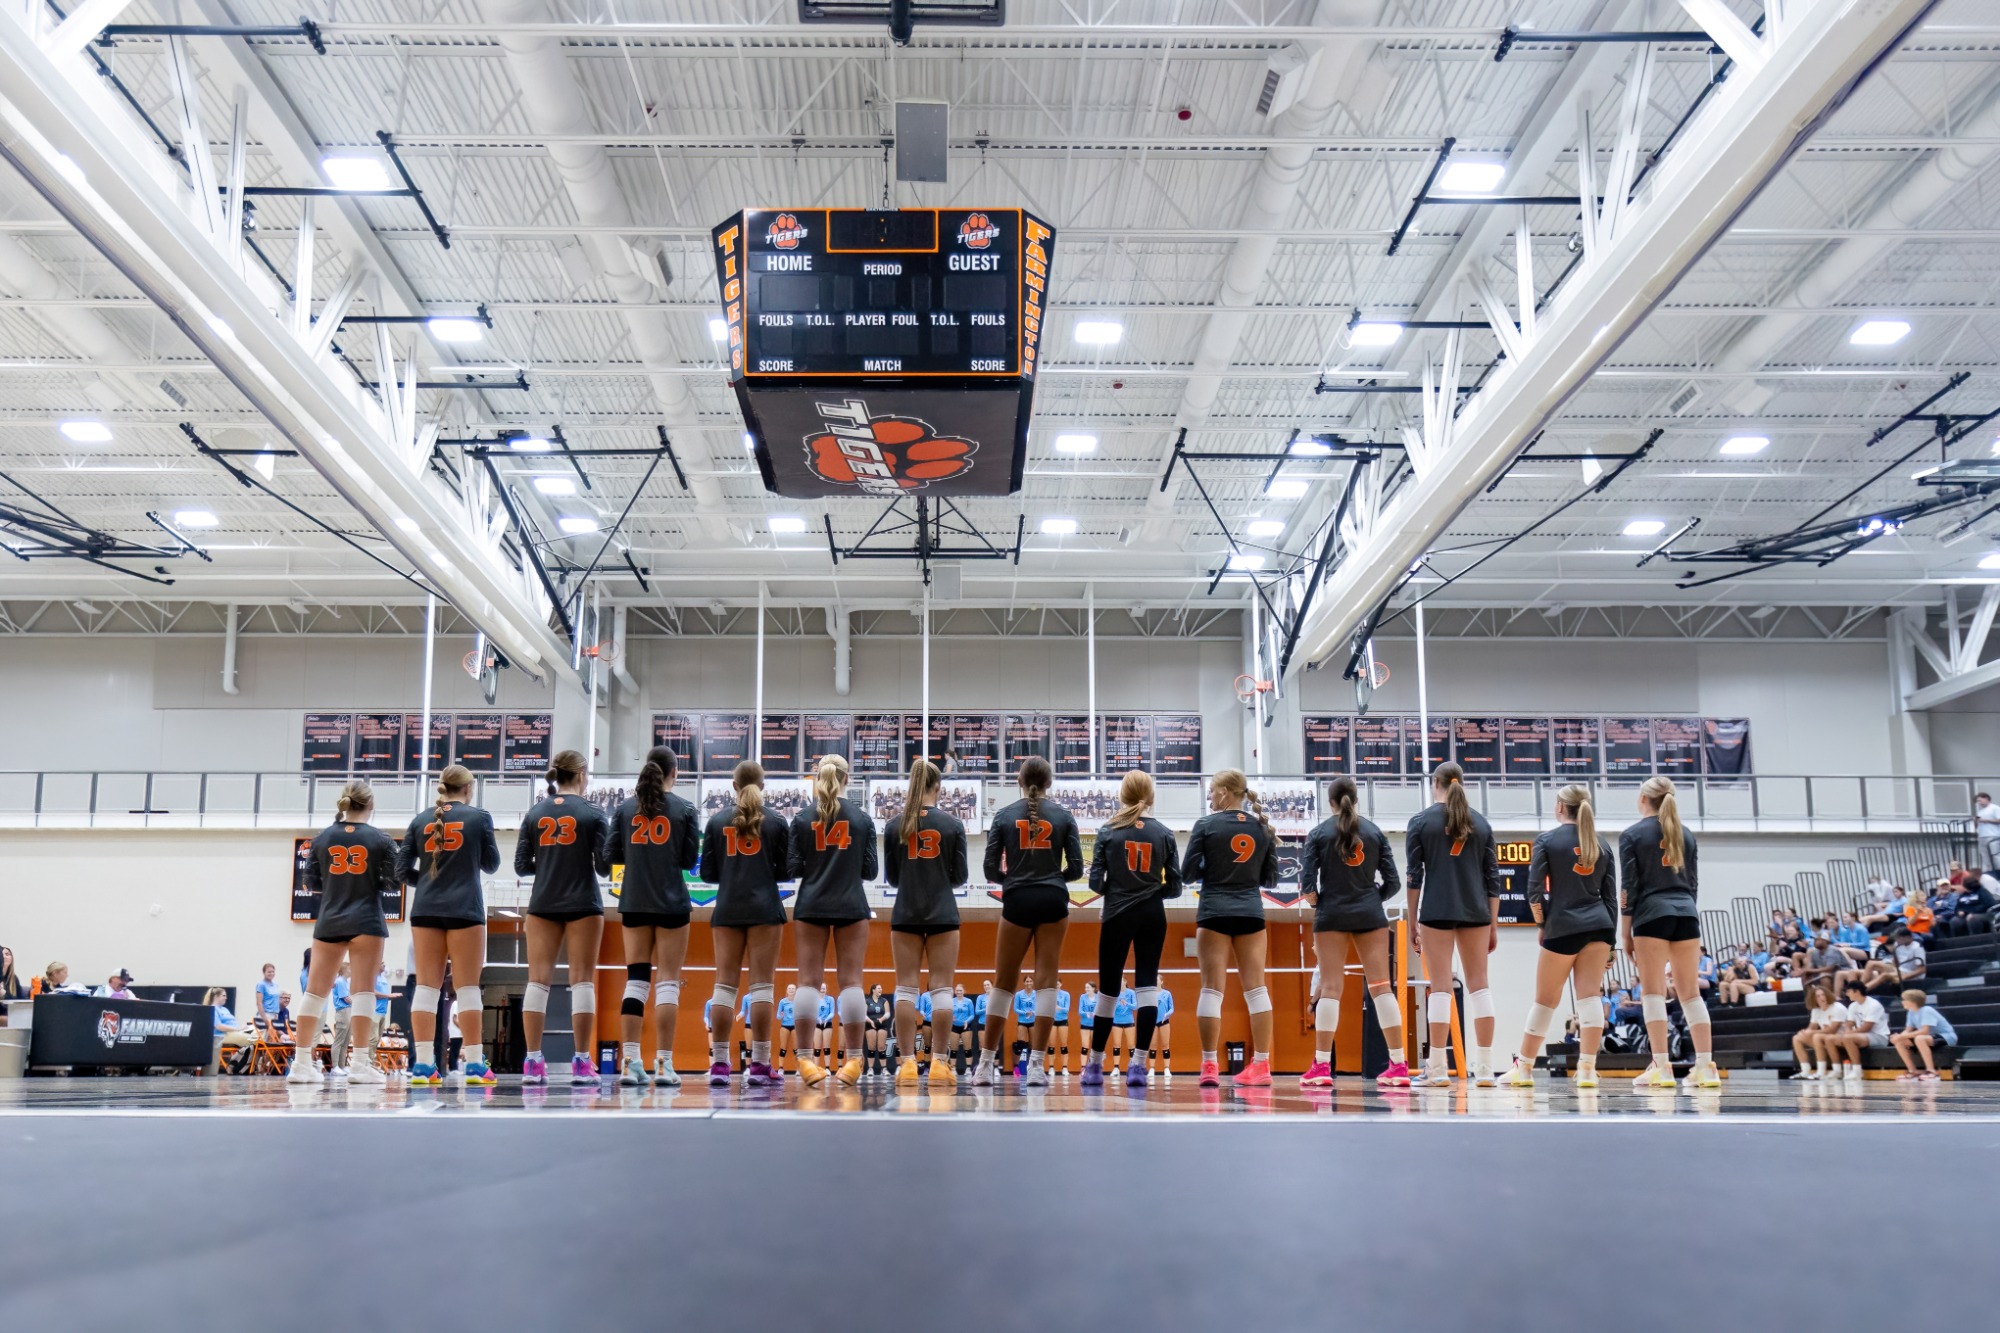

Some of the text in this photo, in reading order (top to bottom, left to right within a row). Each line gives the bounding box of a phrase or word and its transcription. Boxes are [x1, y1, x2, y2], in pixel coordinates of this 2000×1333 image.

[765, 227, 808, 244] TIGERS
[957, 227, 1000, 244] TIGERS
[767, 256, 812, 271] HOME
[864, 264, 902, 275] PERIOD
[949, 255, 1000, 271] GUEST
[718, 224, 741, 370] TIGERS
[1025, 217, 1050, 375] FARMINGTON
[759, 315, 793, 326] FOULS
[806, 315, 835, 326] T.O.L.
[845, 315, 919, 326] PLAYER FOUL
[930, 315, 959, 326] T.O.L.
[971, 315, 1005, 326] FOULS
[759, 360, 793, 372] SCORE
[864, 360, 901, 371] MATCH
[971, 360, 1005, 371] SCORE
[815, 398, 910, 496] TIGERS
[424, 821, 464, 853] 25
[538, 816, 577, 847] 23
[631, 814, 671, 845] 20
[812, 820, 852, 851] 14
[1016, 819, 1053, 849] 12
[723, 826, 761, 857] 16
[907, 829, 942, 859] 13
[1230, 833, 1256, 863] 9
[328, 845, 368, 875] 33
[1125, 840, 1152, 873] 11
[121, 1018, 192, 1037] FARMINGTON
